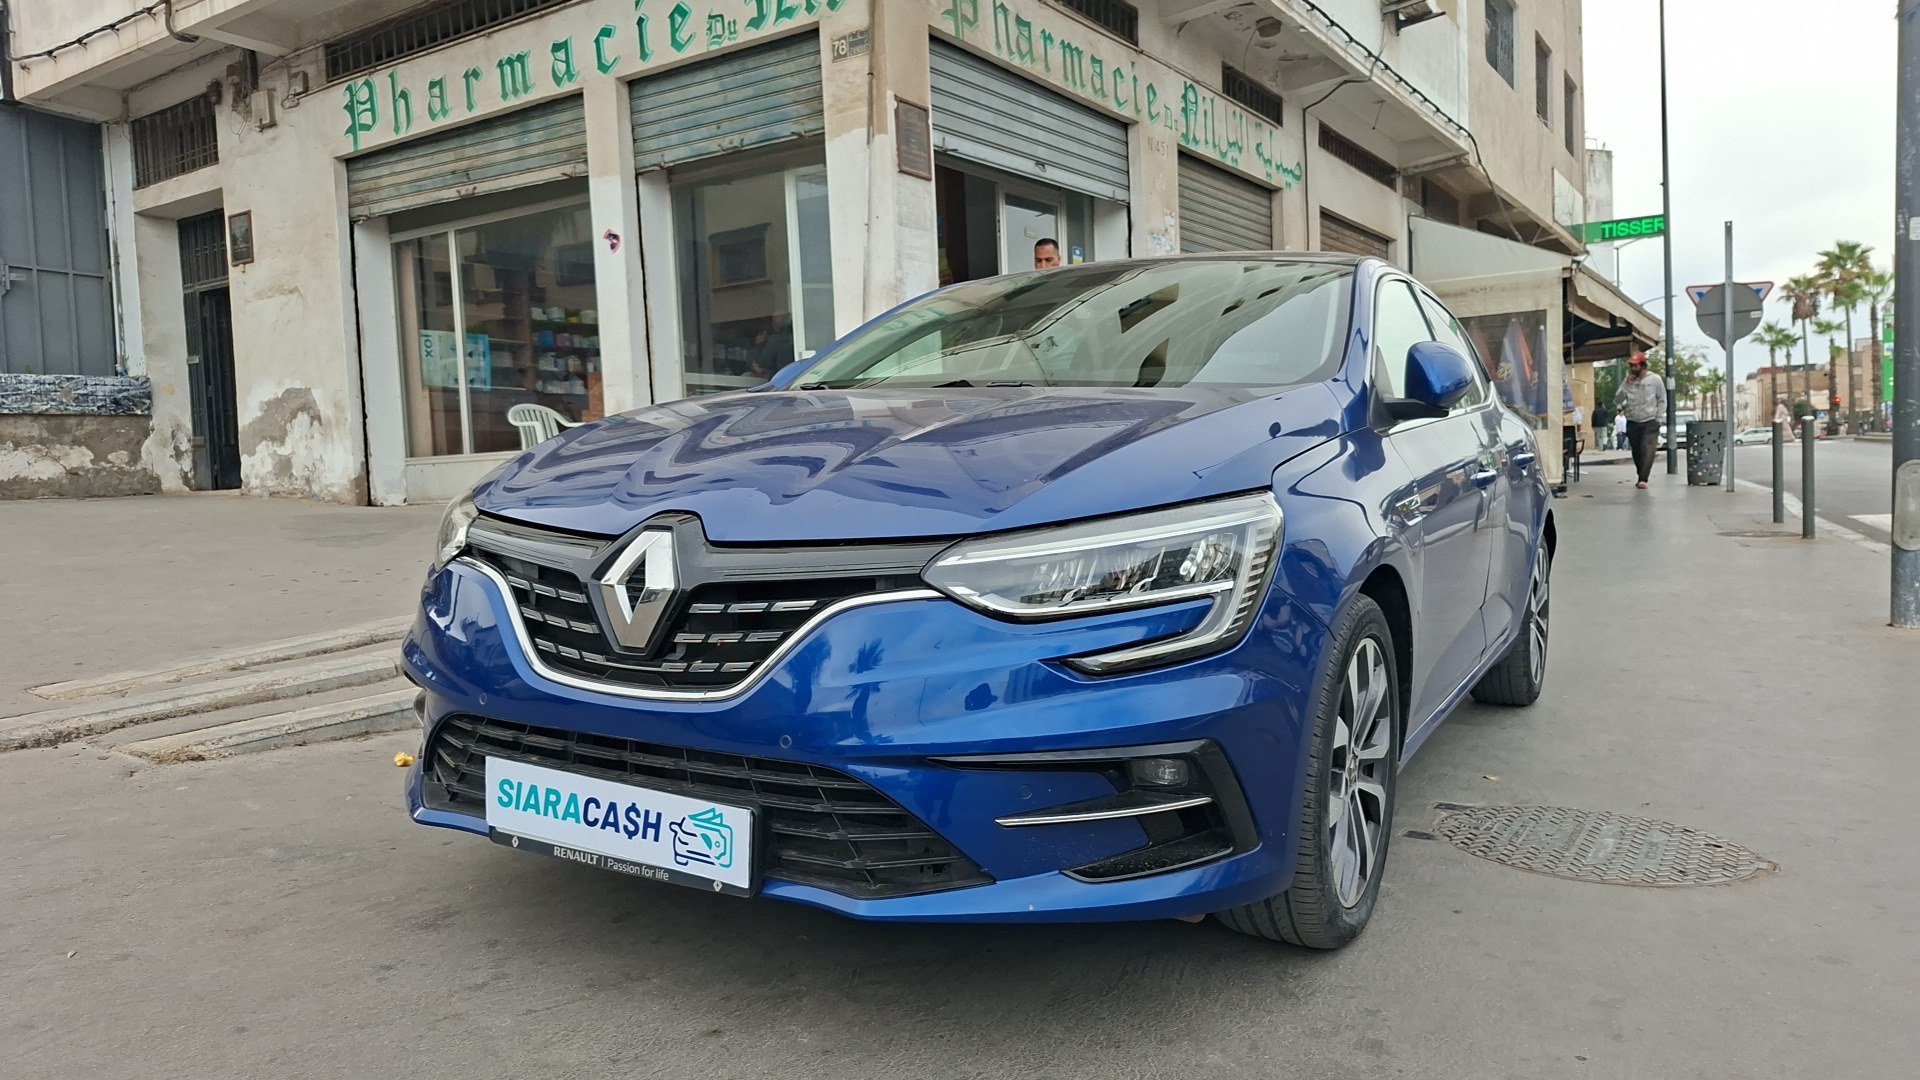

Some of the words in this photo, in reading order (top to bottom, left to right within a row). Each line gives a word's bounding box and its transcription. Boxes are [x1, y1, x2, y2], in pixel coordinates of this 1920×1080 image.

[342, 0, 698, 151] Pharmacie
[706, 7, 739, 48] Du
[832, 39, 847, 58] 78
[1180, 80, 1219, 149] Nil
[1216, 104, 1250, 167] النيل
[1254, 121, 1303, 190] صيدلية
[497, 778, 662, 843] SIARACA$H
[553, 846, 599, 867] RENAULT
[607, 858, 641, 876] Passion
[641, 865, 655, 878] for
[655, 867, 669, 881] life
